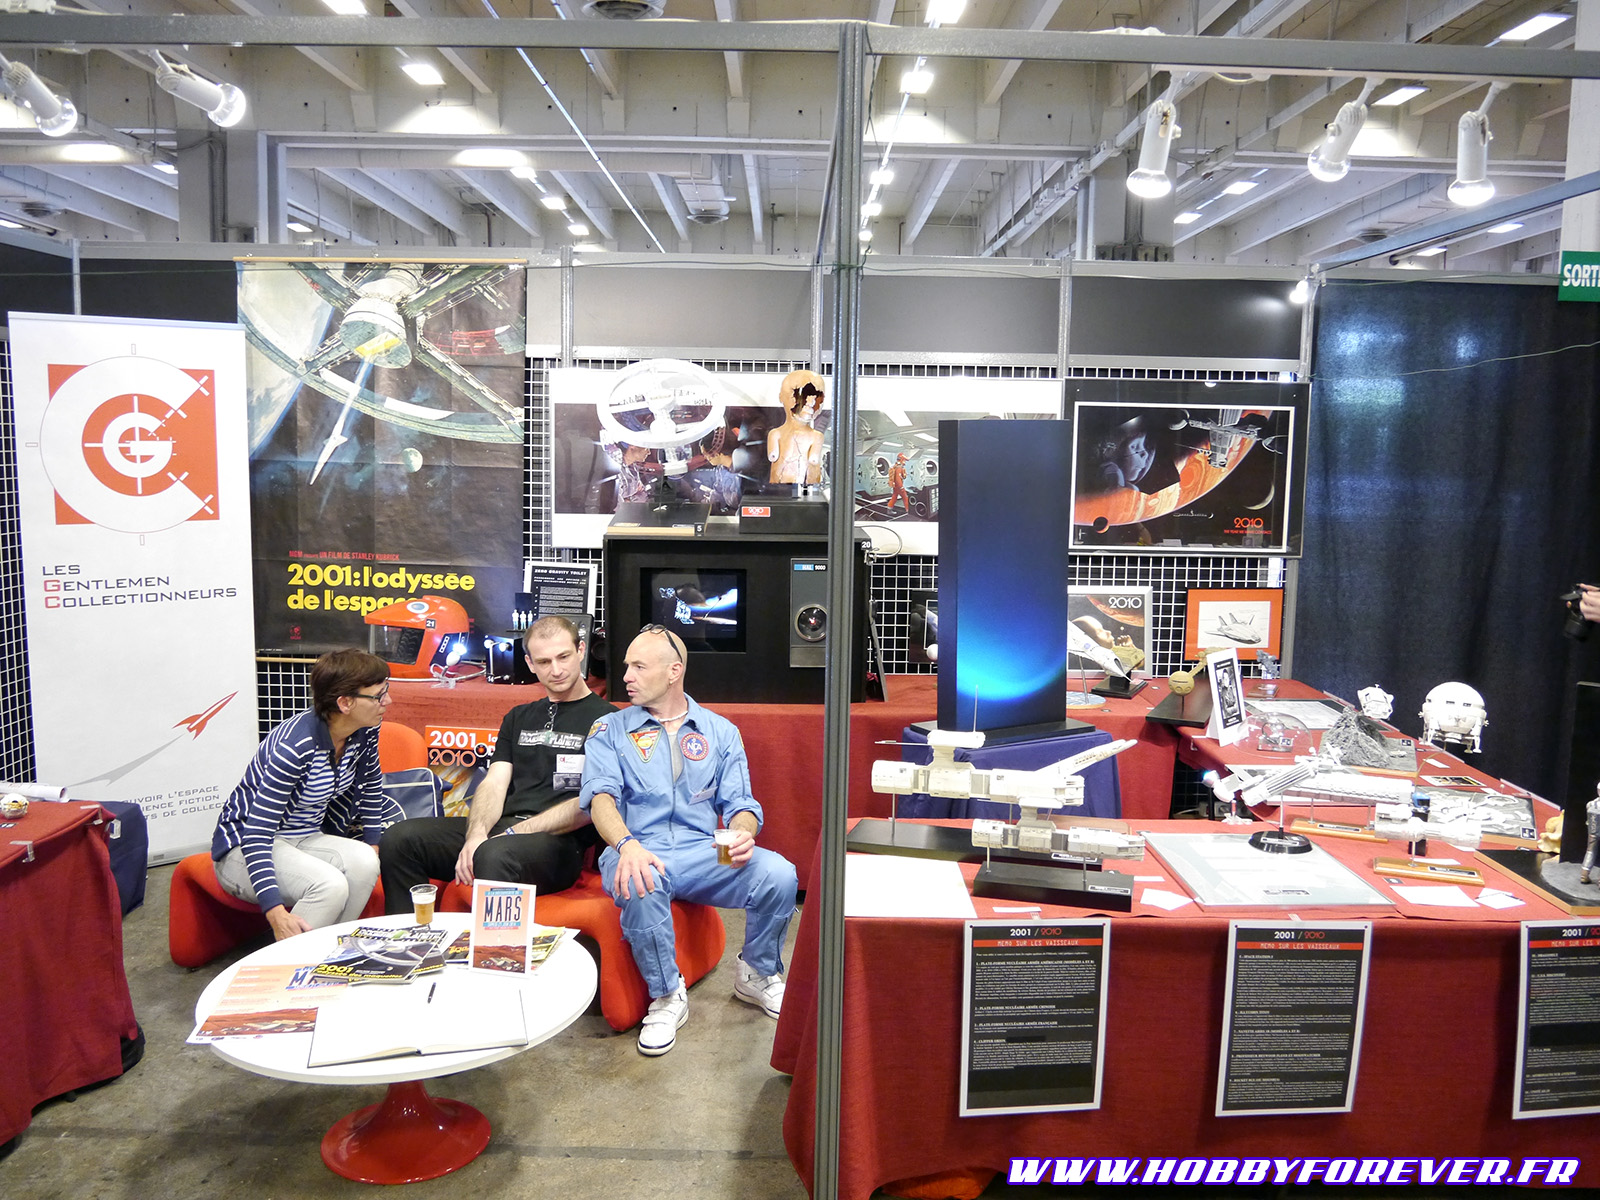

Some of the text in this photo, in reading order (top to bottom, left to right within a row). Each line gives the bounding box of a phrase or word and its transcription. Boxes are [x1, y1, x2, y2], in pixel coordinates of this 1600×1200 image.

[1233, 517, 1264, 528] 2010
[861, 541, 870, 549] 20
[351, 552, 375, 560] STANLEY
[42, 565, 81, 577] LES
[44, 576, 170, 592] GENTLEMEN
[45, 587, 238, 608] COLLECTIONNEURS
[286, 588, 421, 617] de l'espa
[1108, 596, 1142, 609] 2010
[426, 620, 435, 628] 21
[429, 730, 476, 749] 2001
[428, 748, 476, 768] 2010
[168, 785, 219, 798] L'ESPACE
[142, 794, 220, 812] IENCE FICTION
[163, 809, 177, 819] DE
[484, 896, 522, 922] MARS
[1010, 928, 1031, 936] 2001
[1040, 927, 1062, 935] 2010
[1274, 931, 1295, 939] 2001
[1304, 931, 1325, 939] 2010
[1562, 928, 1582, 937] 2001
[317, 964, 355, 974] 2001
